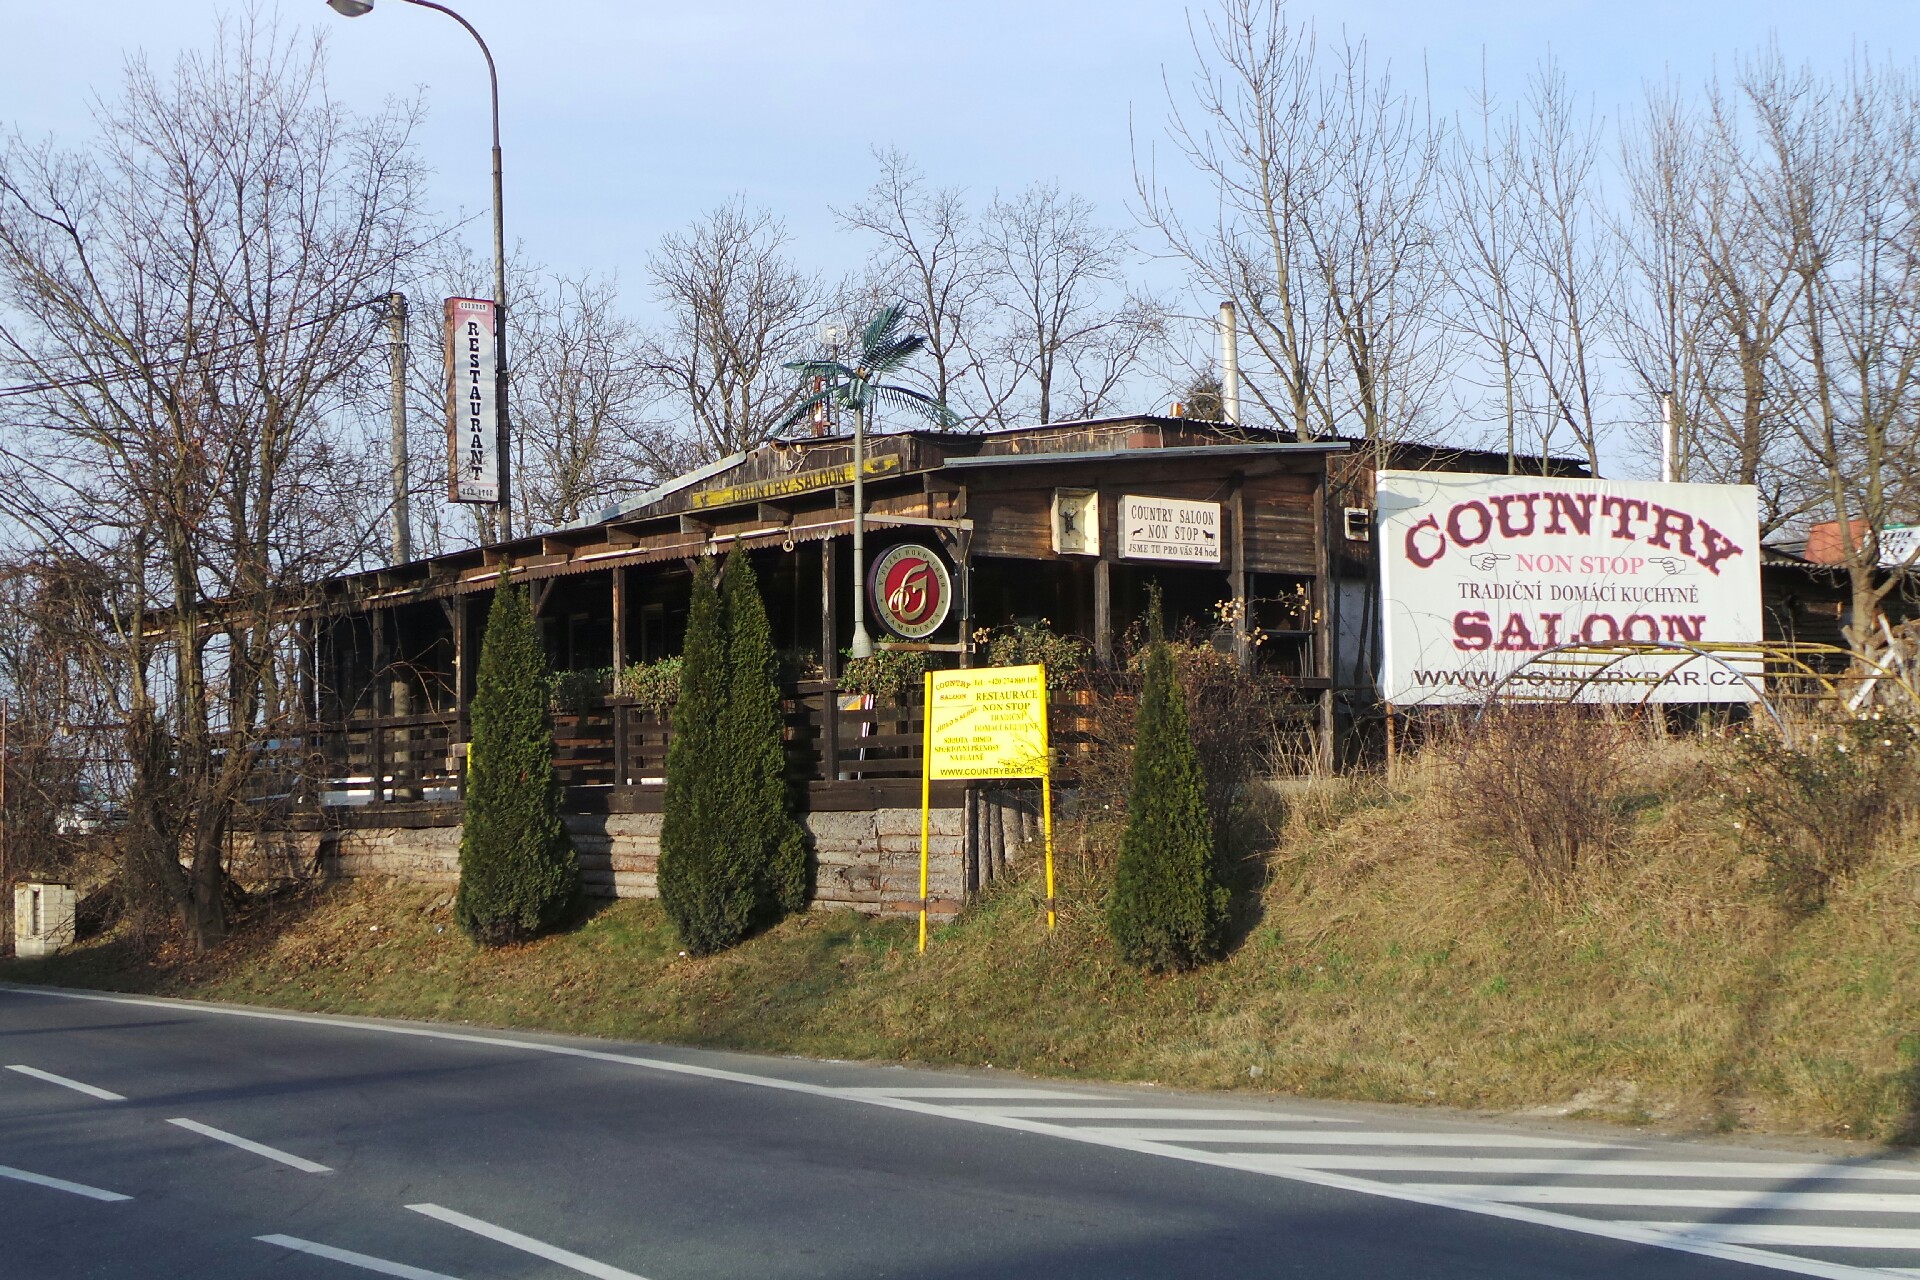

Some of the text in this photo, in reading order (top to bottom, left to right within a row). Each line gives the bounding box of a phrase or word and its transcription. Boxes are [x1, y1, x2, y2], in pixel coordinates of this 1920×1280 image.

[467, 321, 483, 481] RESTAURANT
[732, 468, 846, 502] COUNTRY SALOON
[1131, 505, 1214, 526] COUNTRY SALOON
[1148, 524, 1199, 541] NON STOP
[1405, 491, 1743, 576] COUNTRY
[1128, 543, 1148, 553] JSME
[1151, 545, 1161, 554] TU
[1163, 545, 1178, 555] PRO
[1194, 546, 1203, 556] 24
[1204, 547, 1218, 557] hod.
[1515, 553, 1644, 575] NON STOP
[1458, 580, 1699, 604] TRADIČNÍ DOMÁCÍ KUCHYNĚ
[885, 612, 940, 633] GAMBRINUS
[1452, 610, 1706, 651] SALOON
[936, 679, 971, 690] COUNTRY
[976, 689, 1038, 701] RESTAURACE
[982, 702, 1030, 712] NON STOP
